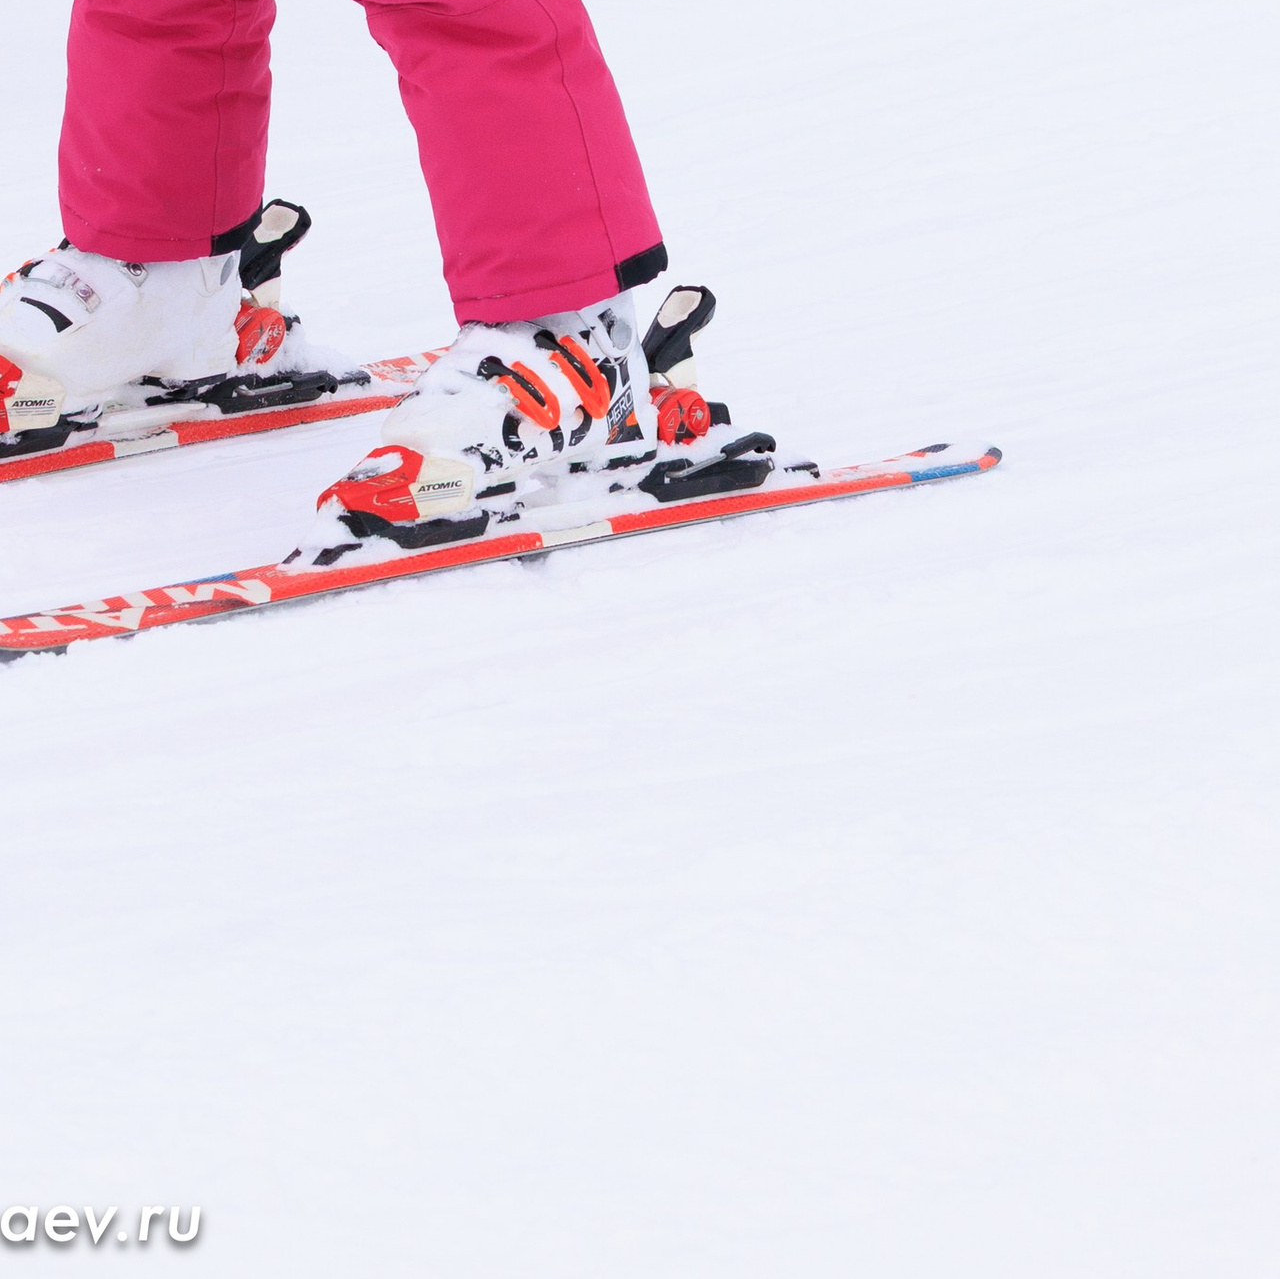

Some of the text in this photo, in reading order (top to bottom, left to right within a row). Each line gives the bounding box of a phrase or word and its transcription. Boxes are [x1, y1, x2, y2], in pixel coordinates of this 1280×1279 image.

[11, 398, 55, 409] ATOMIC
[606, 389, 634, 430] HERO
[418, 480, 462, 493] ATOMIC
